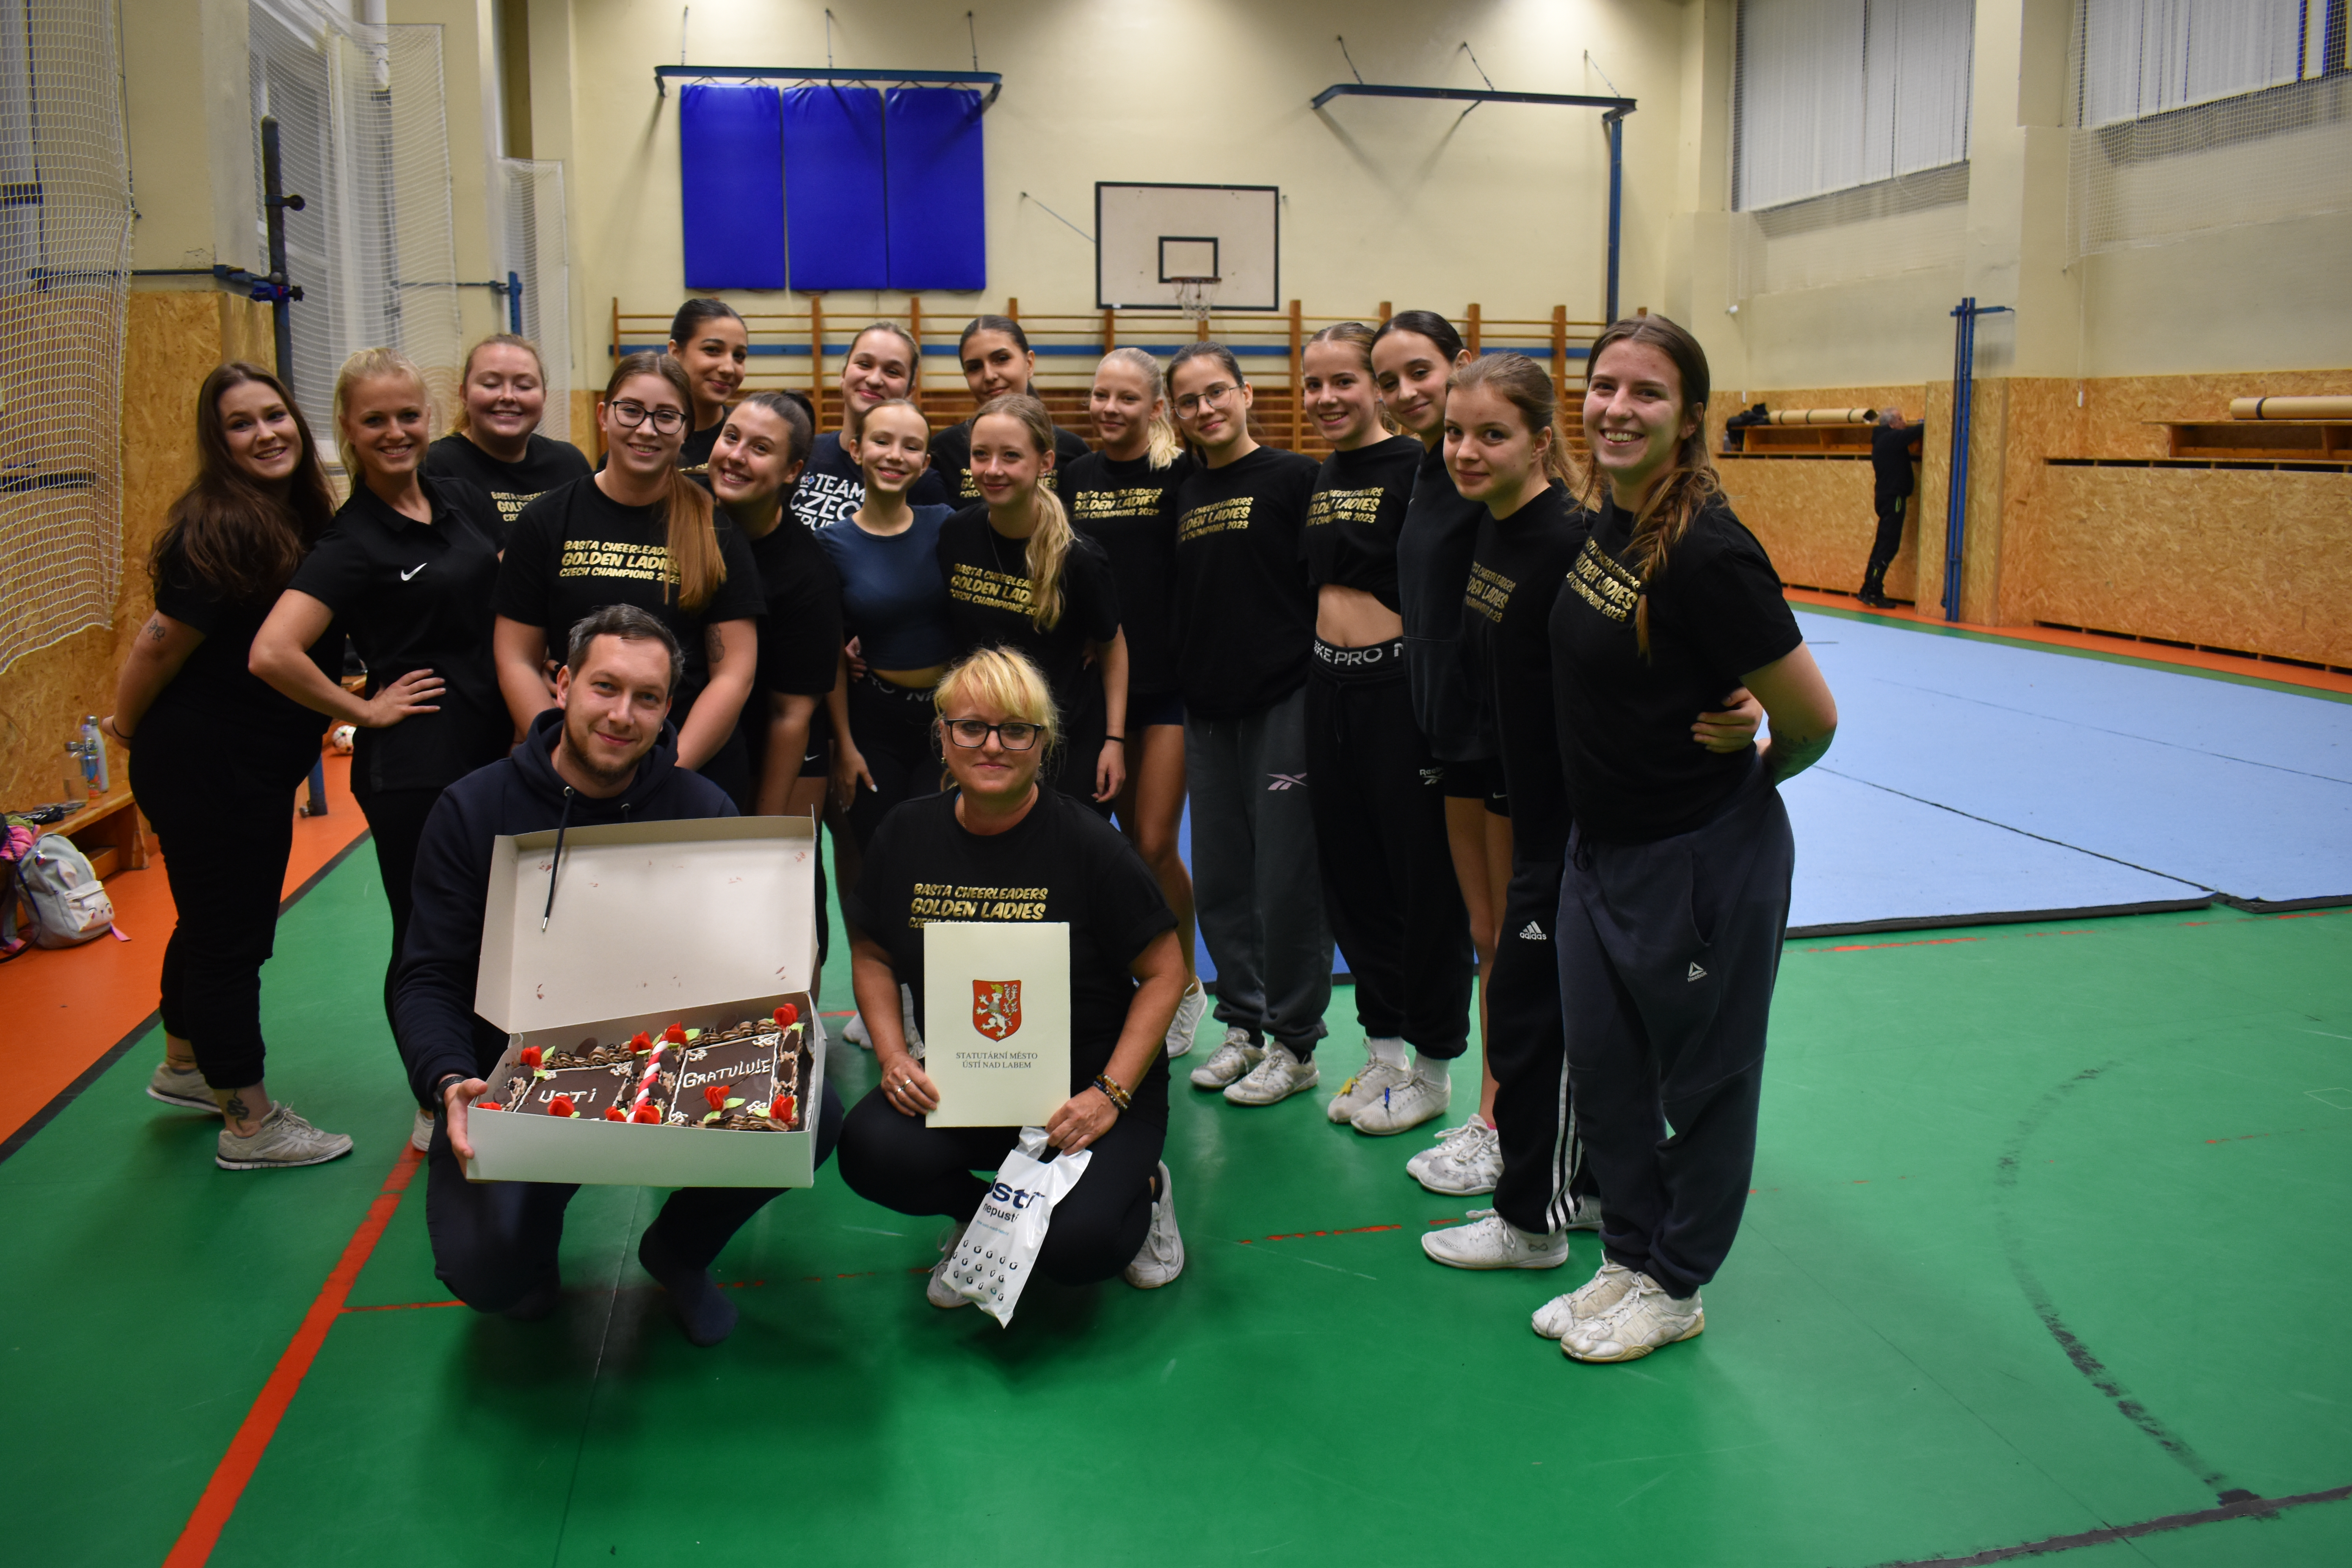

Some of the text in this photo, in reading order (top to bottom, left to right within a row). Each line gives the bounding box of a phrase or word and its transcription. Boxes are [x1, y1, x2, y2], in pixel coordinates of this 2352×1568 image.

[814, 473, 866, 503] TEAM
[1100, 488, 1163, 499] CHERLEADERS
[1329, 487, 1385, 497] HEERLEADERS
[497, 500, 528, 512] GOLD
[789, 488, 861, 521] CZEC
[1334, 497, 1381, 512] LADIES
[1208, 506, 1251, 524] LADIES
[1353, 512, 1376, 524] 2023
[1226, 520, 1249, 530] 2023
[563, 540, 668, 556] BASTA CHEERLEADE
[561, 551, 679, 573] GOLDEN LADI
[559, 566, 680, 584] CZECH CHAMPIONS 223
[954, 563, 1034, 590] BASTA CHEERLEA
[950, 574, 1031, 603] GOLDEN LAD
[1481, 584, 1509, 609] LADIES
[972, 594, 1024, 613] CHAMPIONS
[1024, 606, 1037, 616] 20
[1602, 603, 1627, 622] 2023
[1334, 648, 1383, 666] PRO
[914, 883, 1049, 900] BASTA CHEERLEADERS
[911, 897, 1046, 920] GOLDEN LADIES
[1687, 971, 1708, 982] Reebok
[956, 1051, 1008, 1059] STATUTÁRNÍ
[962, 1060, 980, 1068] ÚSTÍ
[538, 1088, 597, 1103] UTi
